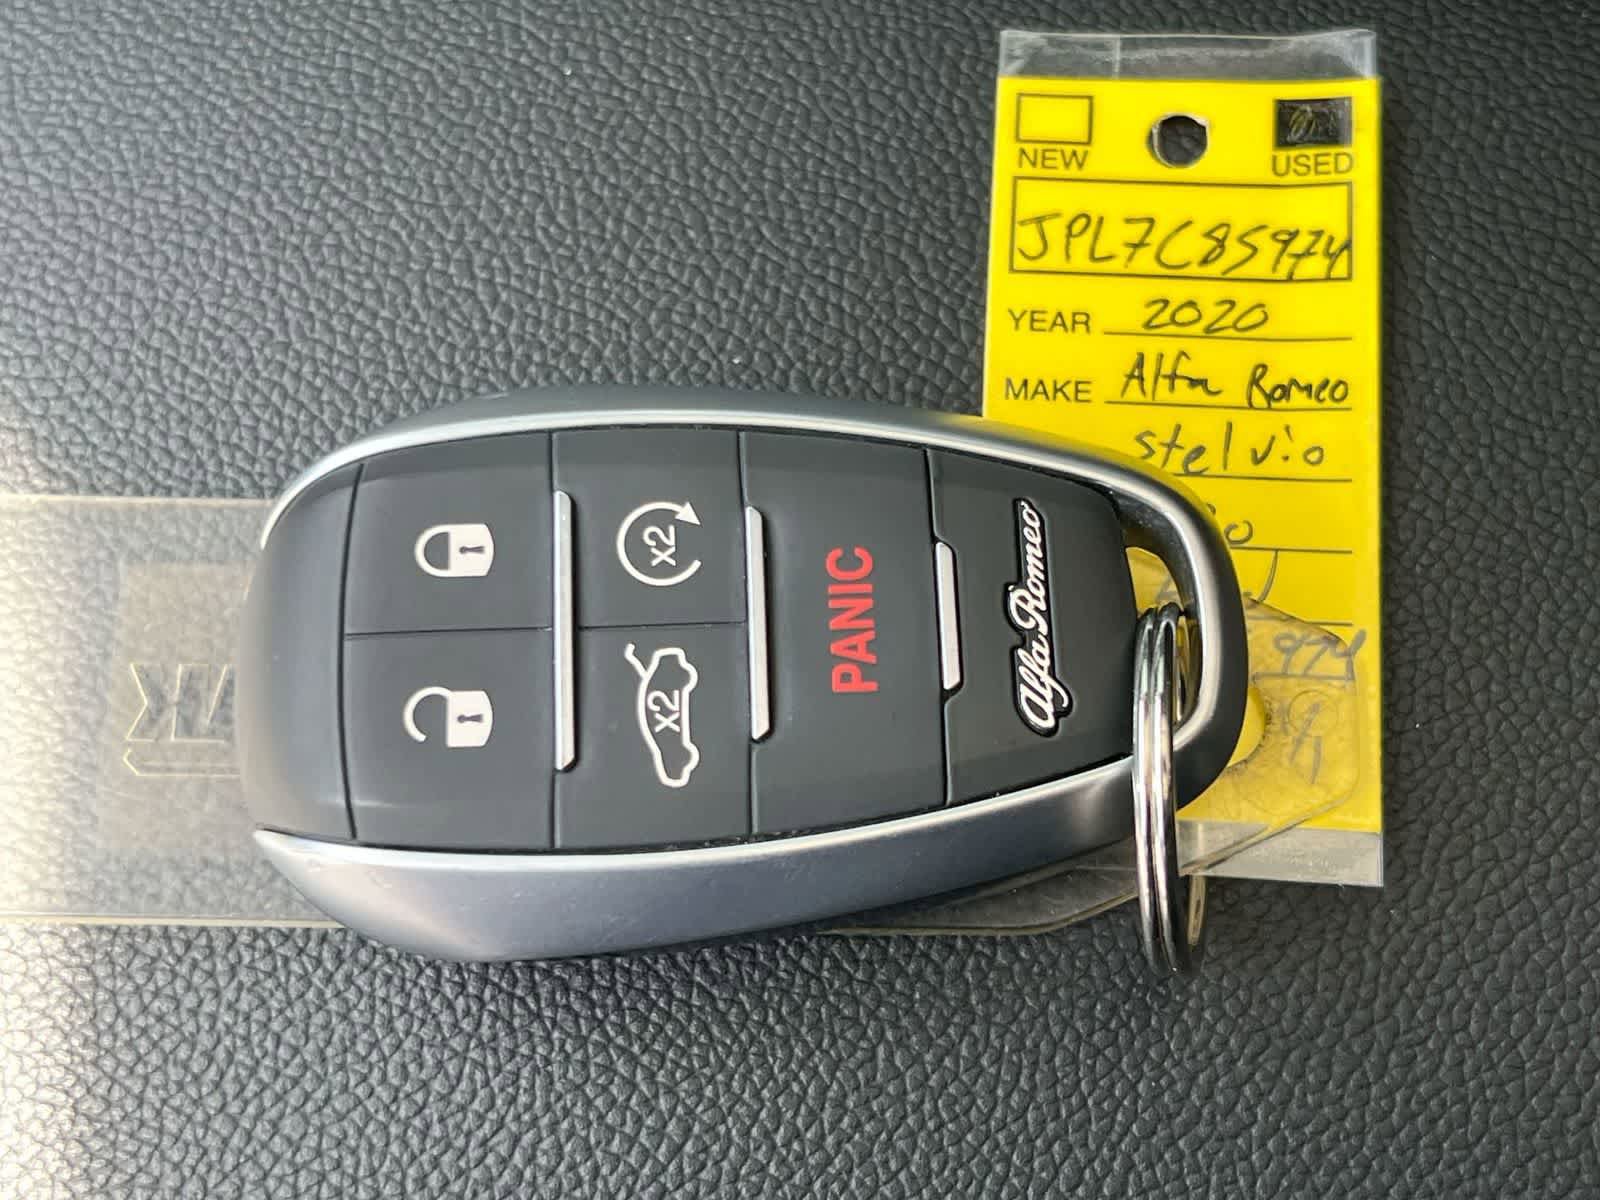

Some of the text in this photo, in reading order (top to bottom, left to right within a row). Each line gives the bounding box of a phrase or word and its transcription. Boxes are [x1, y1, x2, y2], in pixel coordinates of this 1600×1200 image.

[1018, 149, 1089, 169] NEW
[1272, 152, 1353, 176] USED
[1008, 310, 1091, 334] YEAR
[1142, 299, 1268, 334] 2020
[1004, 377, 1092, 402] MAKE
[1246, 362, 1350, 409] Romeo
[1008, 501, 1048, 635] Romeo
[825, 546, 878, 693] PANIC
